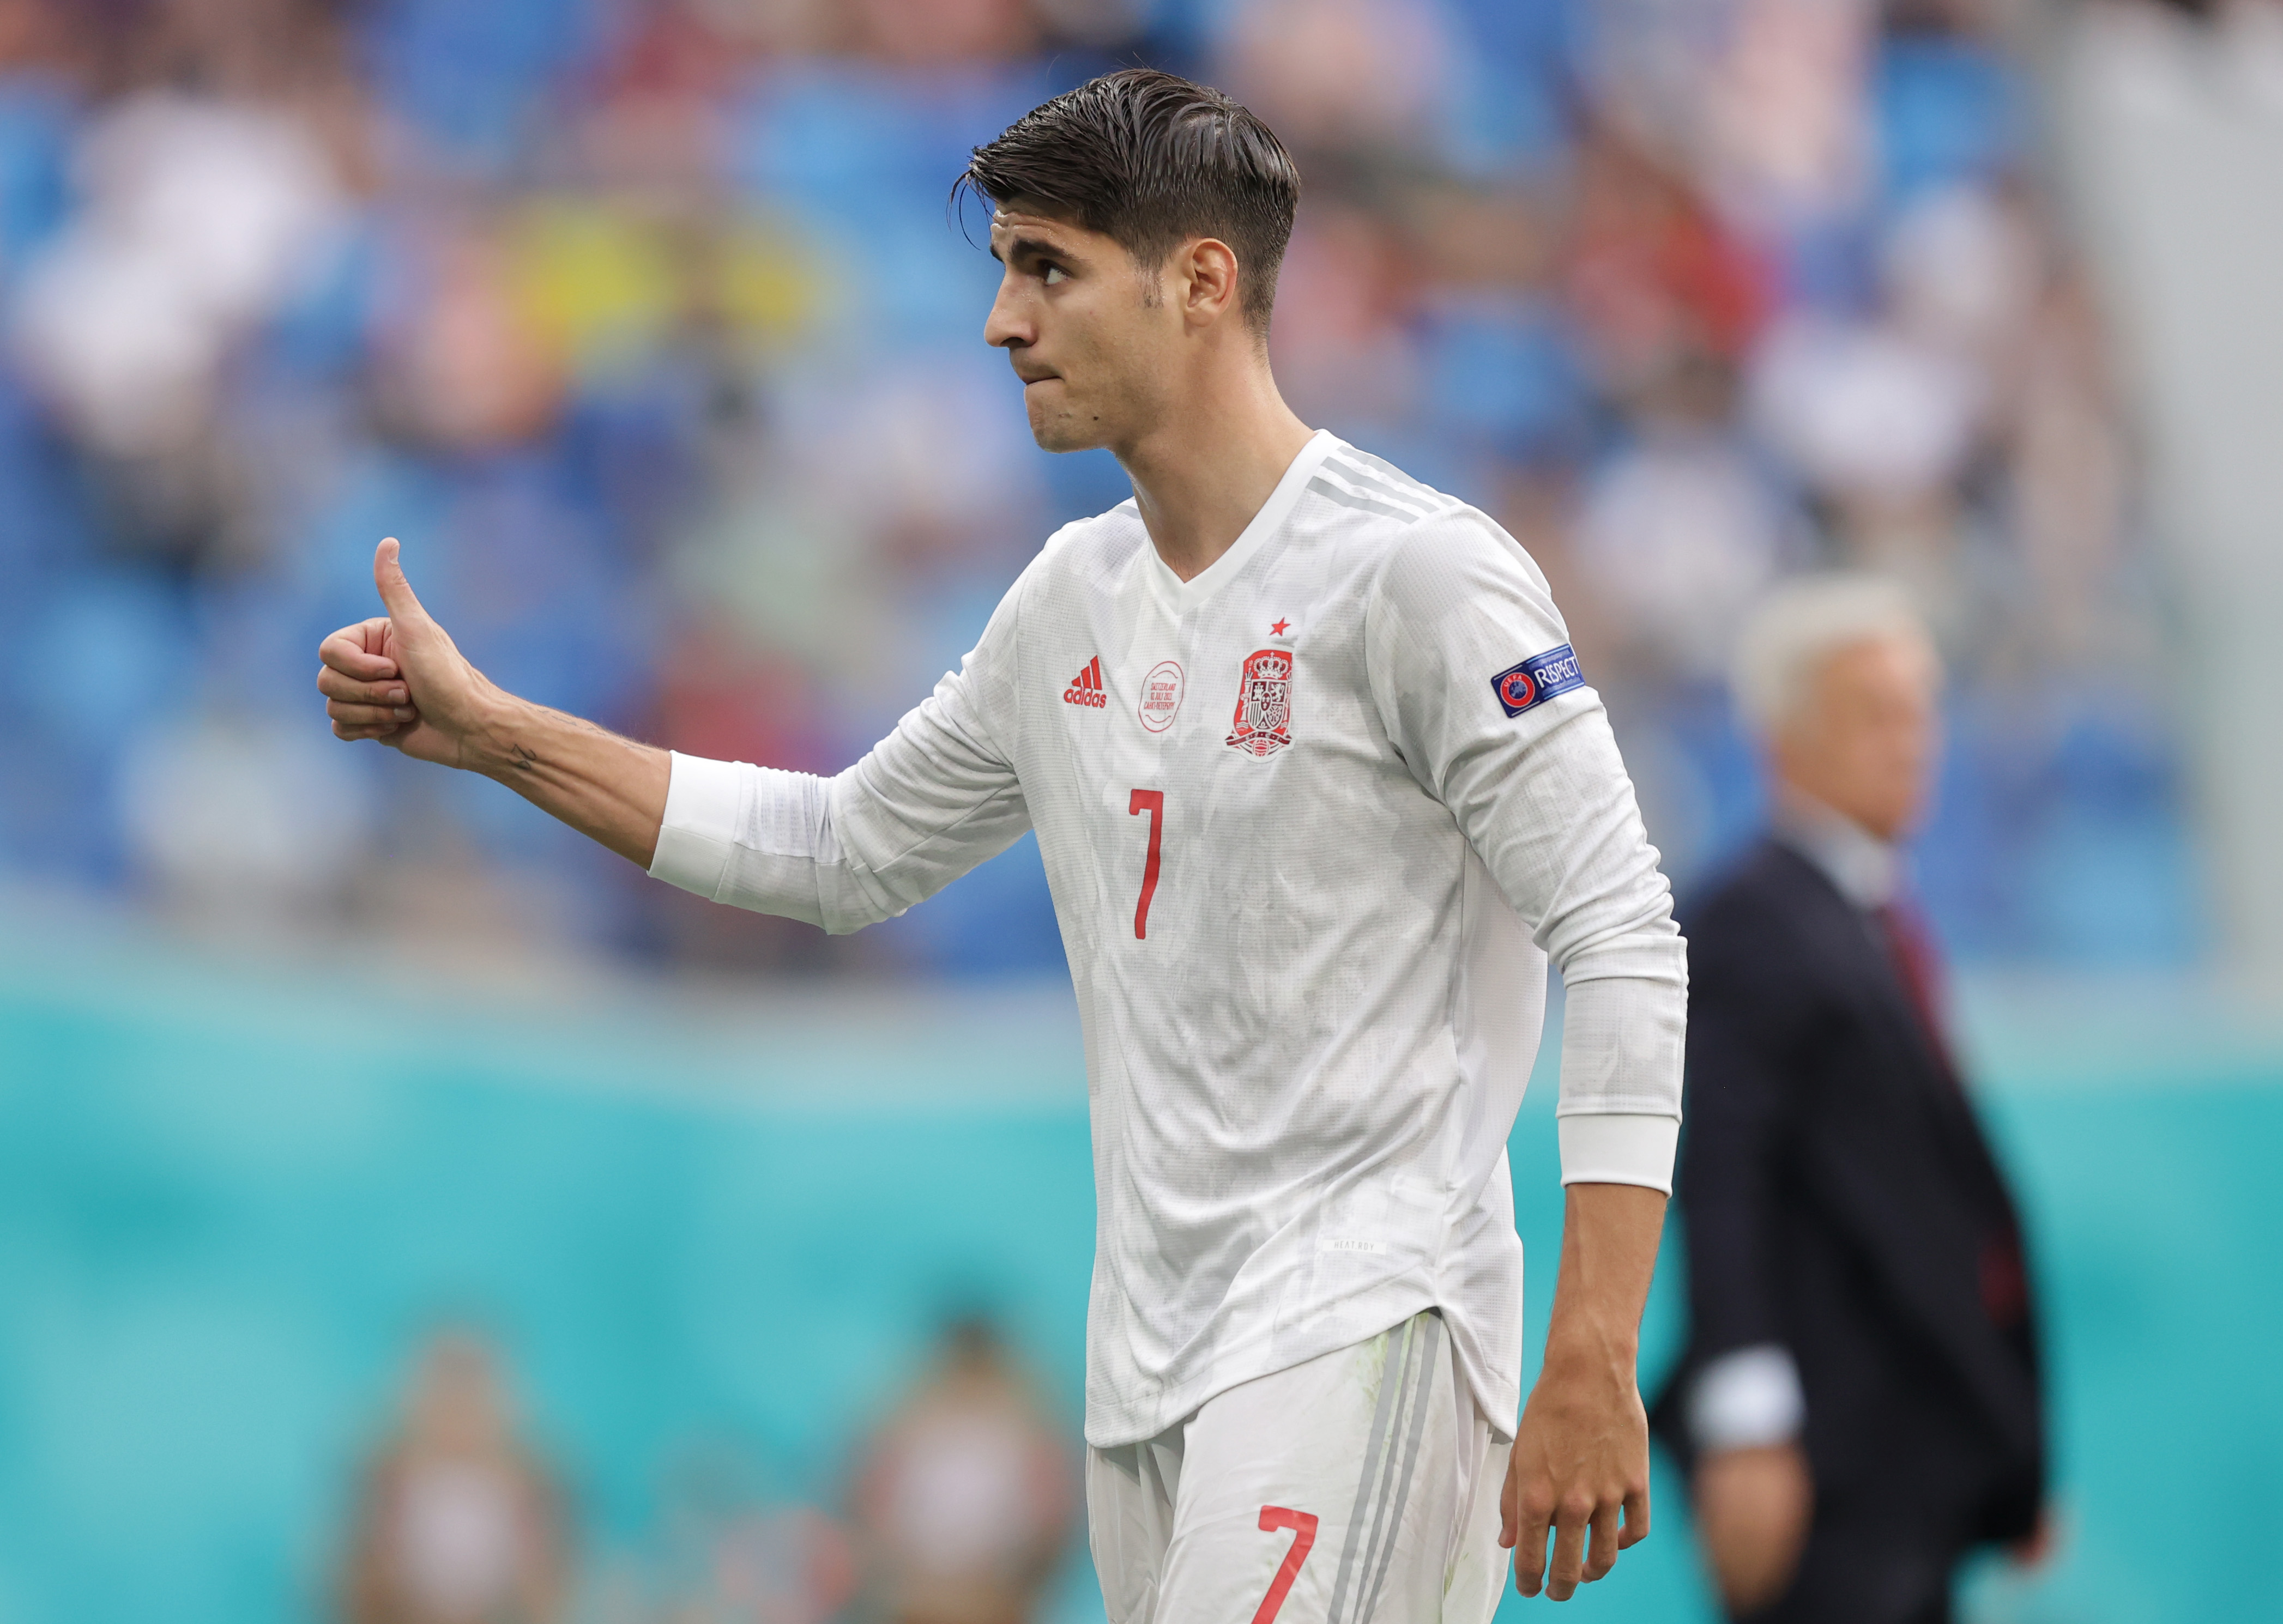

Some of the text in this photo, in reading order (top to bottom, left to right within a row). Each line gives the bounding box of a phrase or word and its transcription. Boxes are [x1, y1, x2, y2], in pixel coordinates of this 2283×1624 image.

[1504, 675, 1522, 687] UEFA
[1535, 656, 1578, 688] RESPECT
[1064, 686, 1107, 708] adidas
[1155, 692, 1164, 700] JULY
[1164, 692, 1173, 700] 2021
[1129, 789, 1163, 940] 7
[1334, 1240, 1374, 1251] HEAT.RDY
[1251, 1505, 1319, 1624] 7
